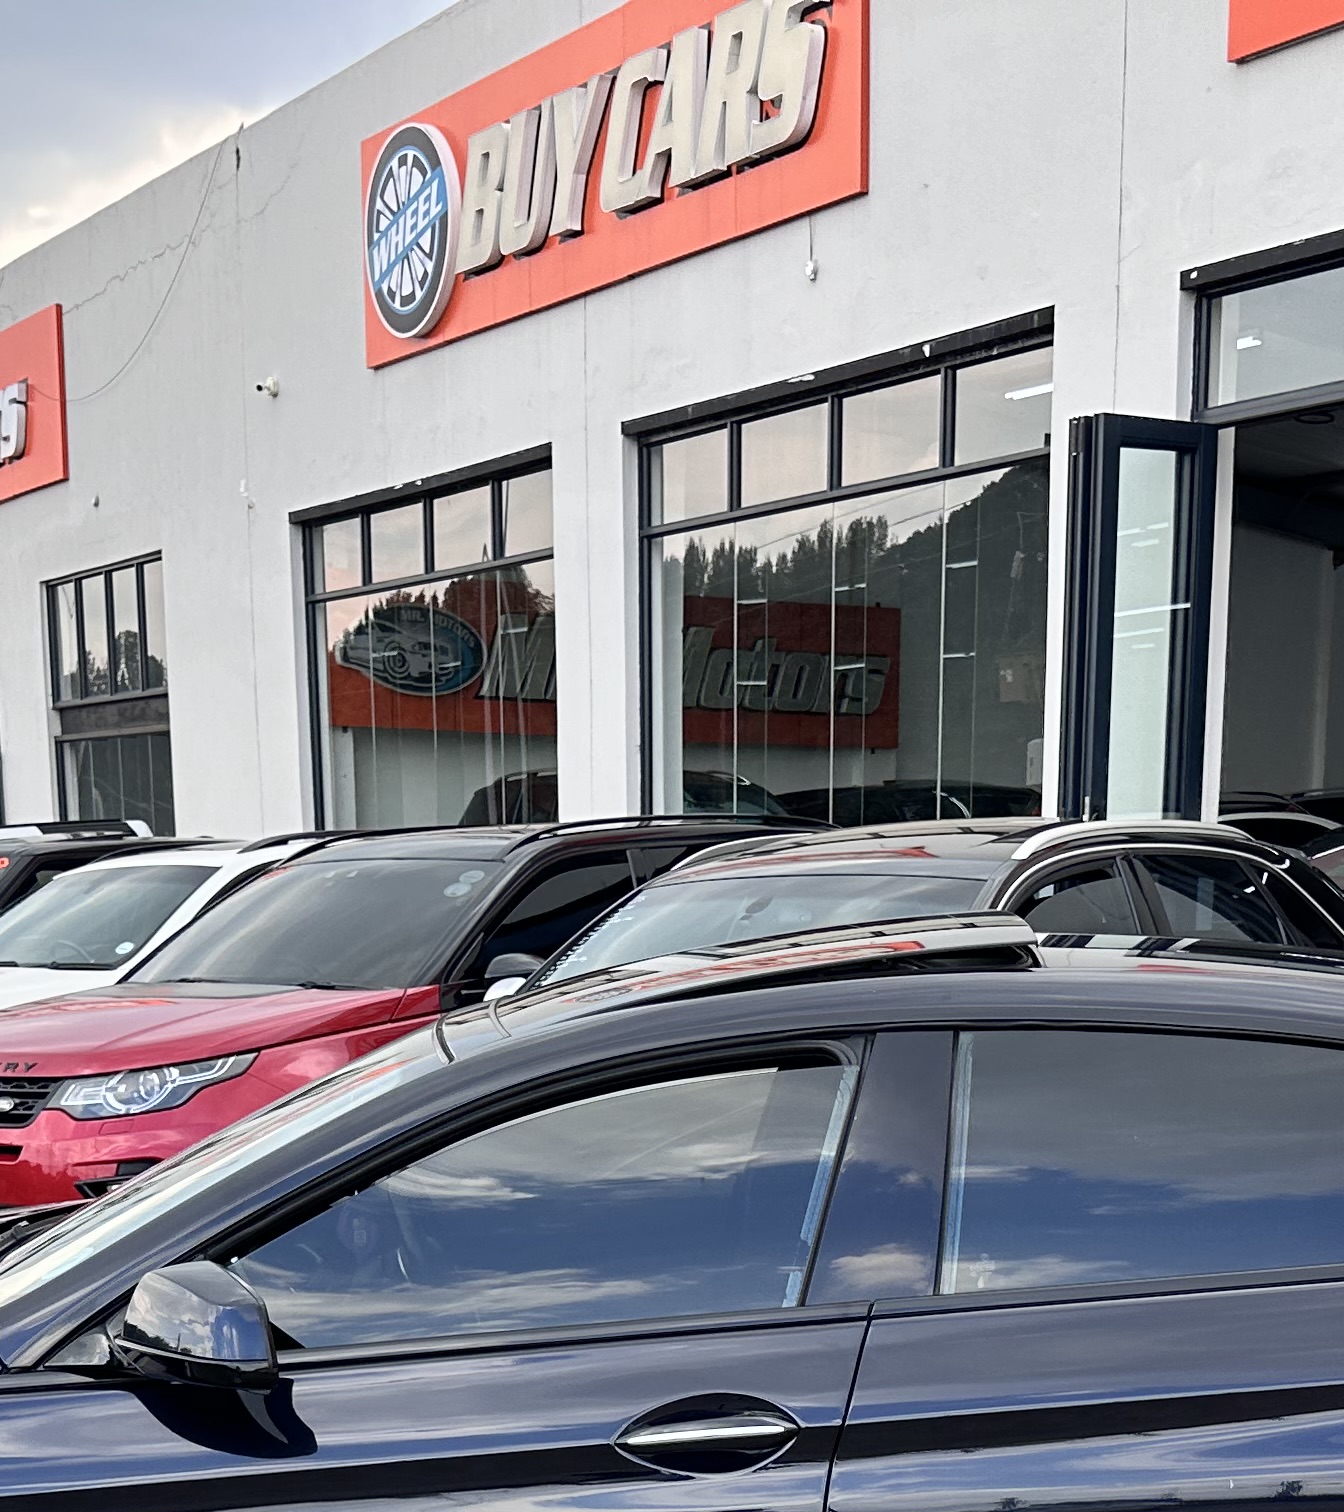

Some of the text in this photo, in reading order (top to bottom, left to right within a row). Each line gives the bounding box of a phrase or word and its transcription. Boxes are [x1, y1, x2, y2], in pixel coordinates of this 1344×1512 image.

[373, 178, 443, 282] WHEEL
[456, 0, 828, 275] BUY CARS
